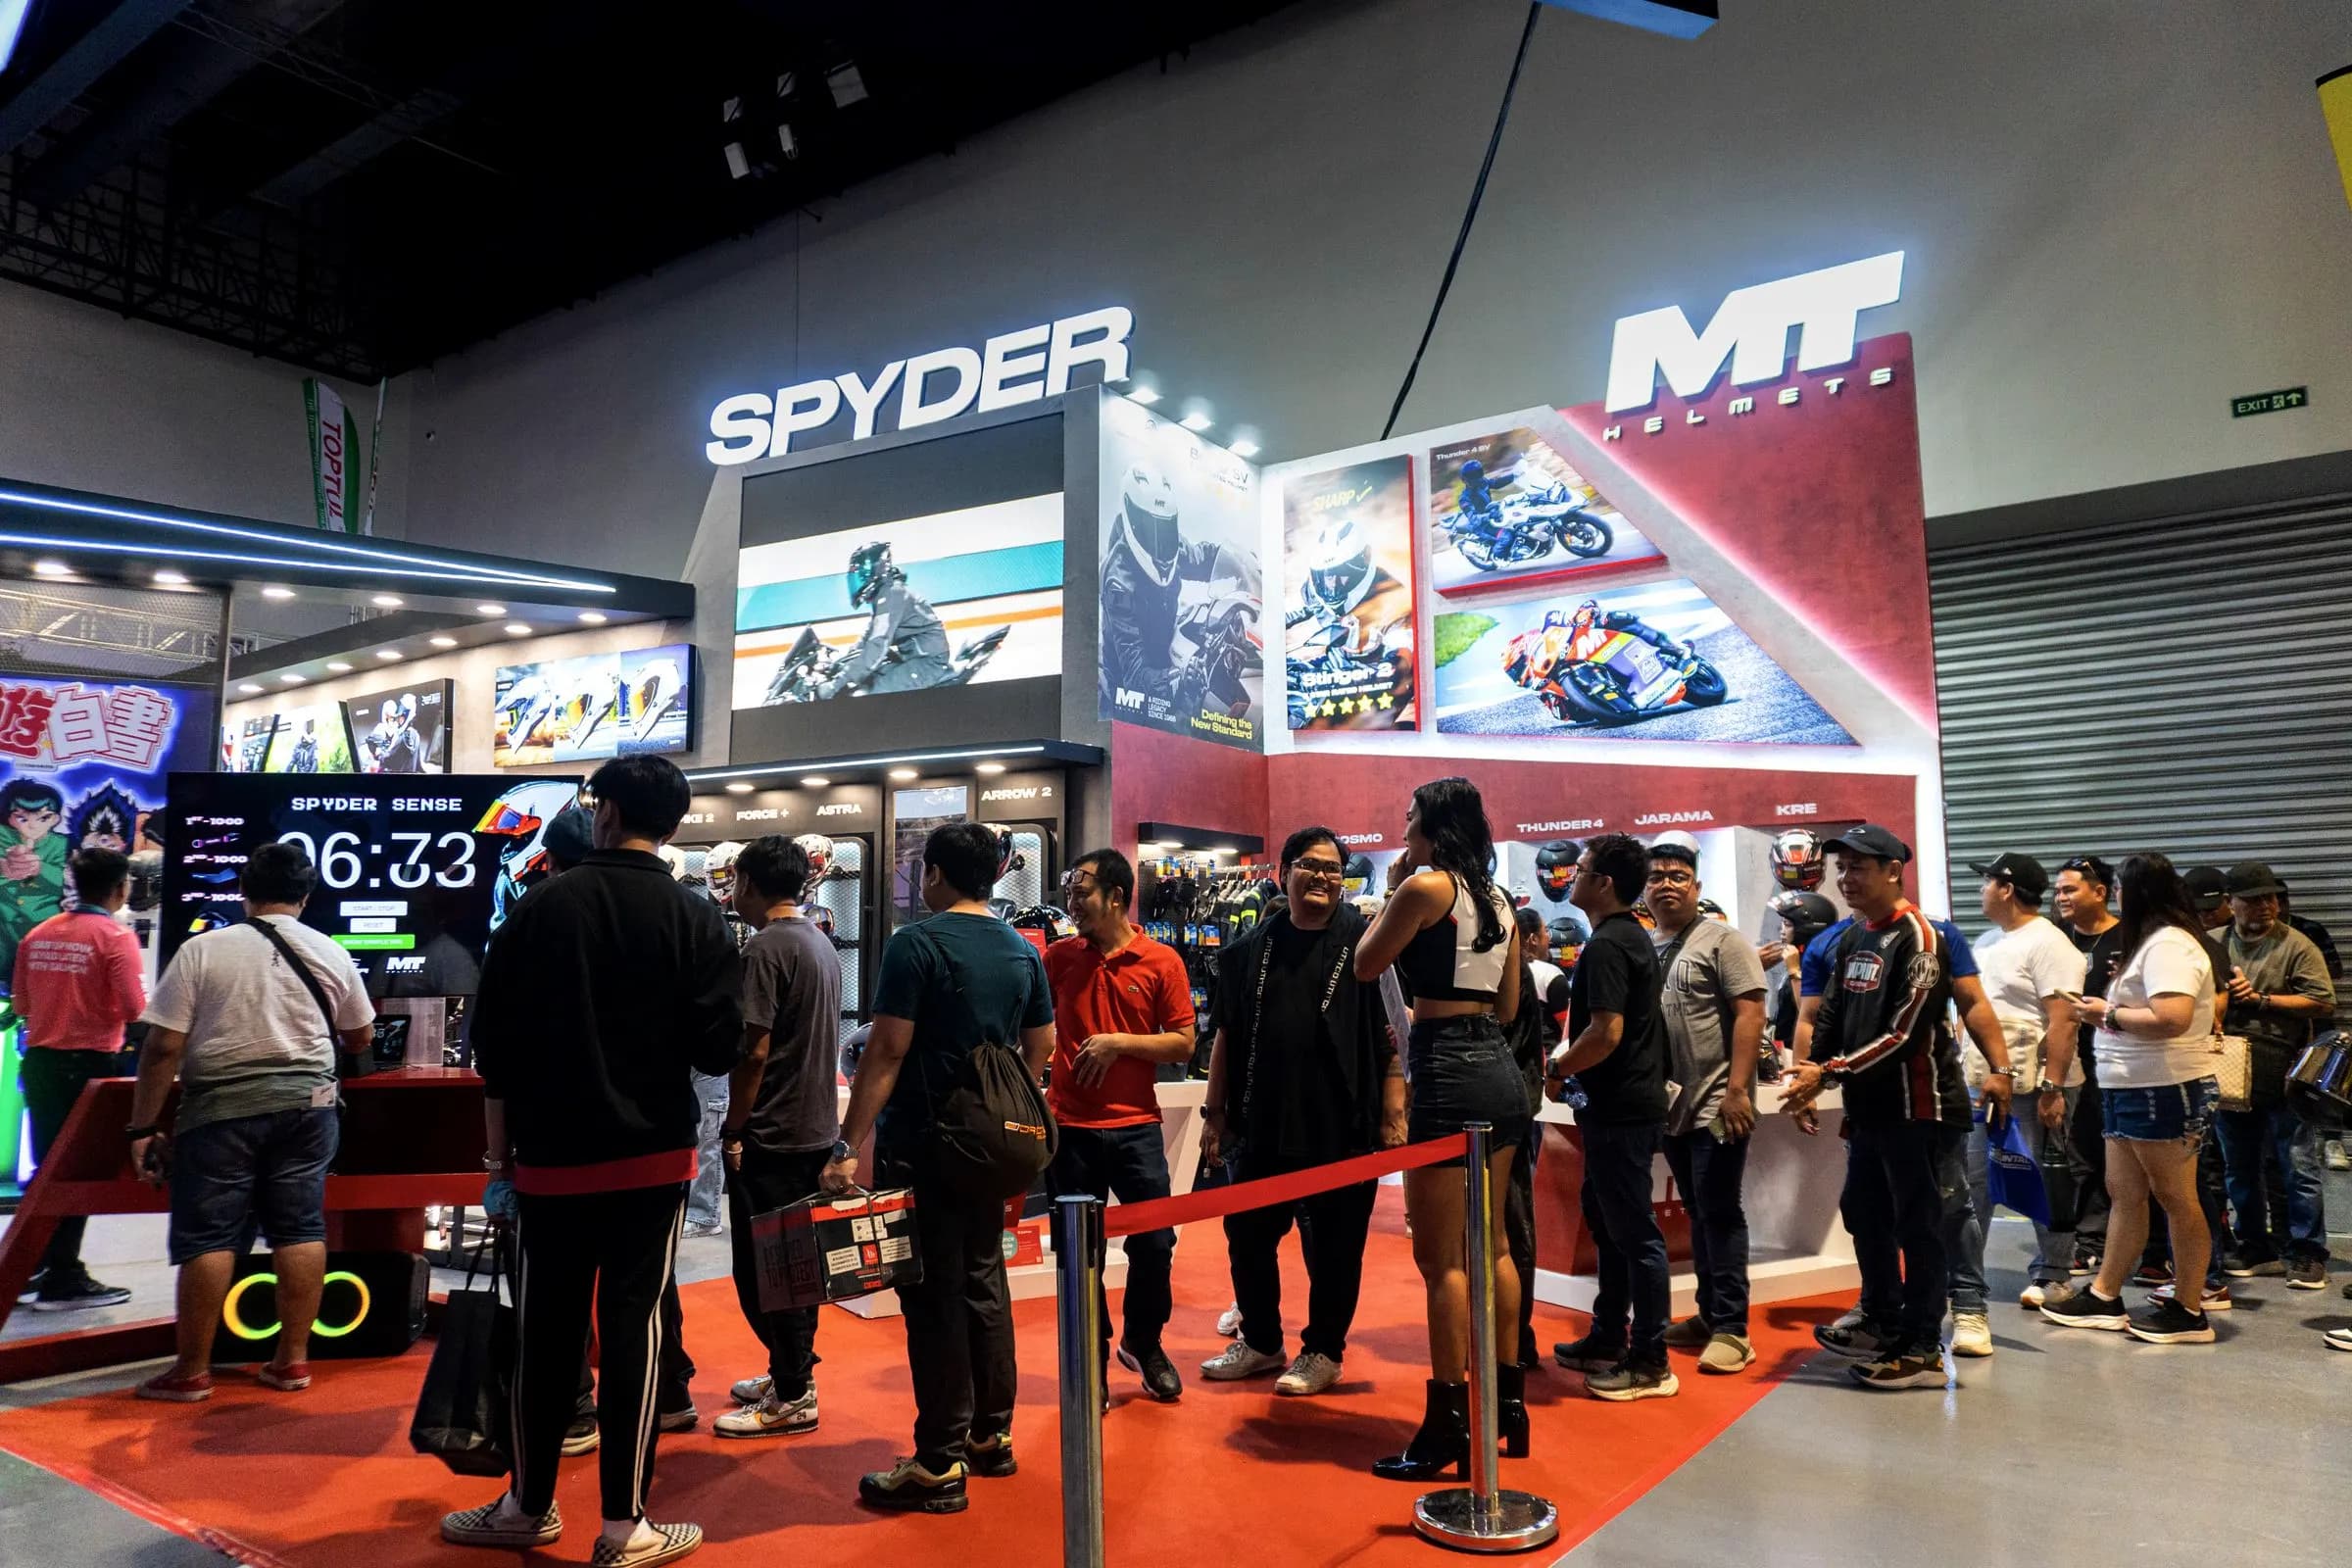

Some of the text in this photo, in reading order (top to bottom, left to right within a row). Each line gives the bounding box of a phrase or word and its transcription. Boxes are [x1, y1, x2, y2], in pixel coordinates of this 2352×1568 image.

[1604, 250, 1905, 414] MT
[705, 306, 1136, 466] SPYDER
[1602, 367, 1892, 441] HELMETS
[2237, 399, 2269, 414] EXIT
[1436, 449, 1470, 461] Thunder
[1312, 490, 1355, 511] SHARP
[1115, 687, 1145, 710] MT
[1201, 709, 1252, 729] Defining the
[1191, 716, 1252, 740] New Standard
[981, 786, 1053, 801] ARROW 2
[291, 797, 463, 811] SPYDER SENSE
[816, 804, 862, 816] ASTRA
[1775, 803, 1818, 816] KRE
[679, 813, 714, 824] IKE 2
[736, 808, 779, 821] FORCE
[1634, 810, 1715, 825] JARAMA
[1516, 818, 1604, 833] THUNDER 4
[1336, 833, 1384, 845] OSMO
[386, 956, 426, 970] MT
[796, 1410, 808, 1420] 24
